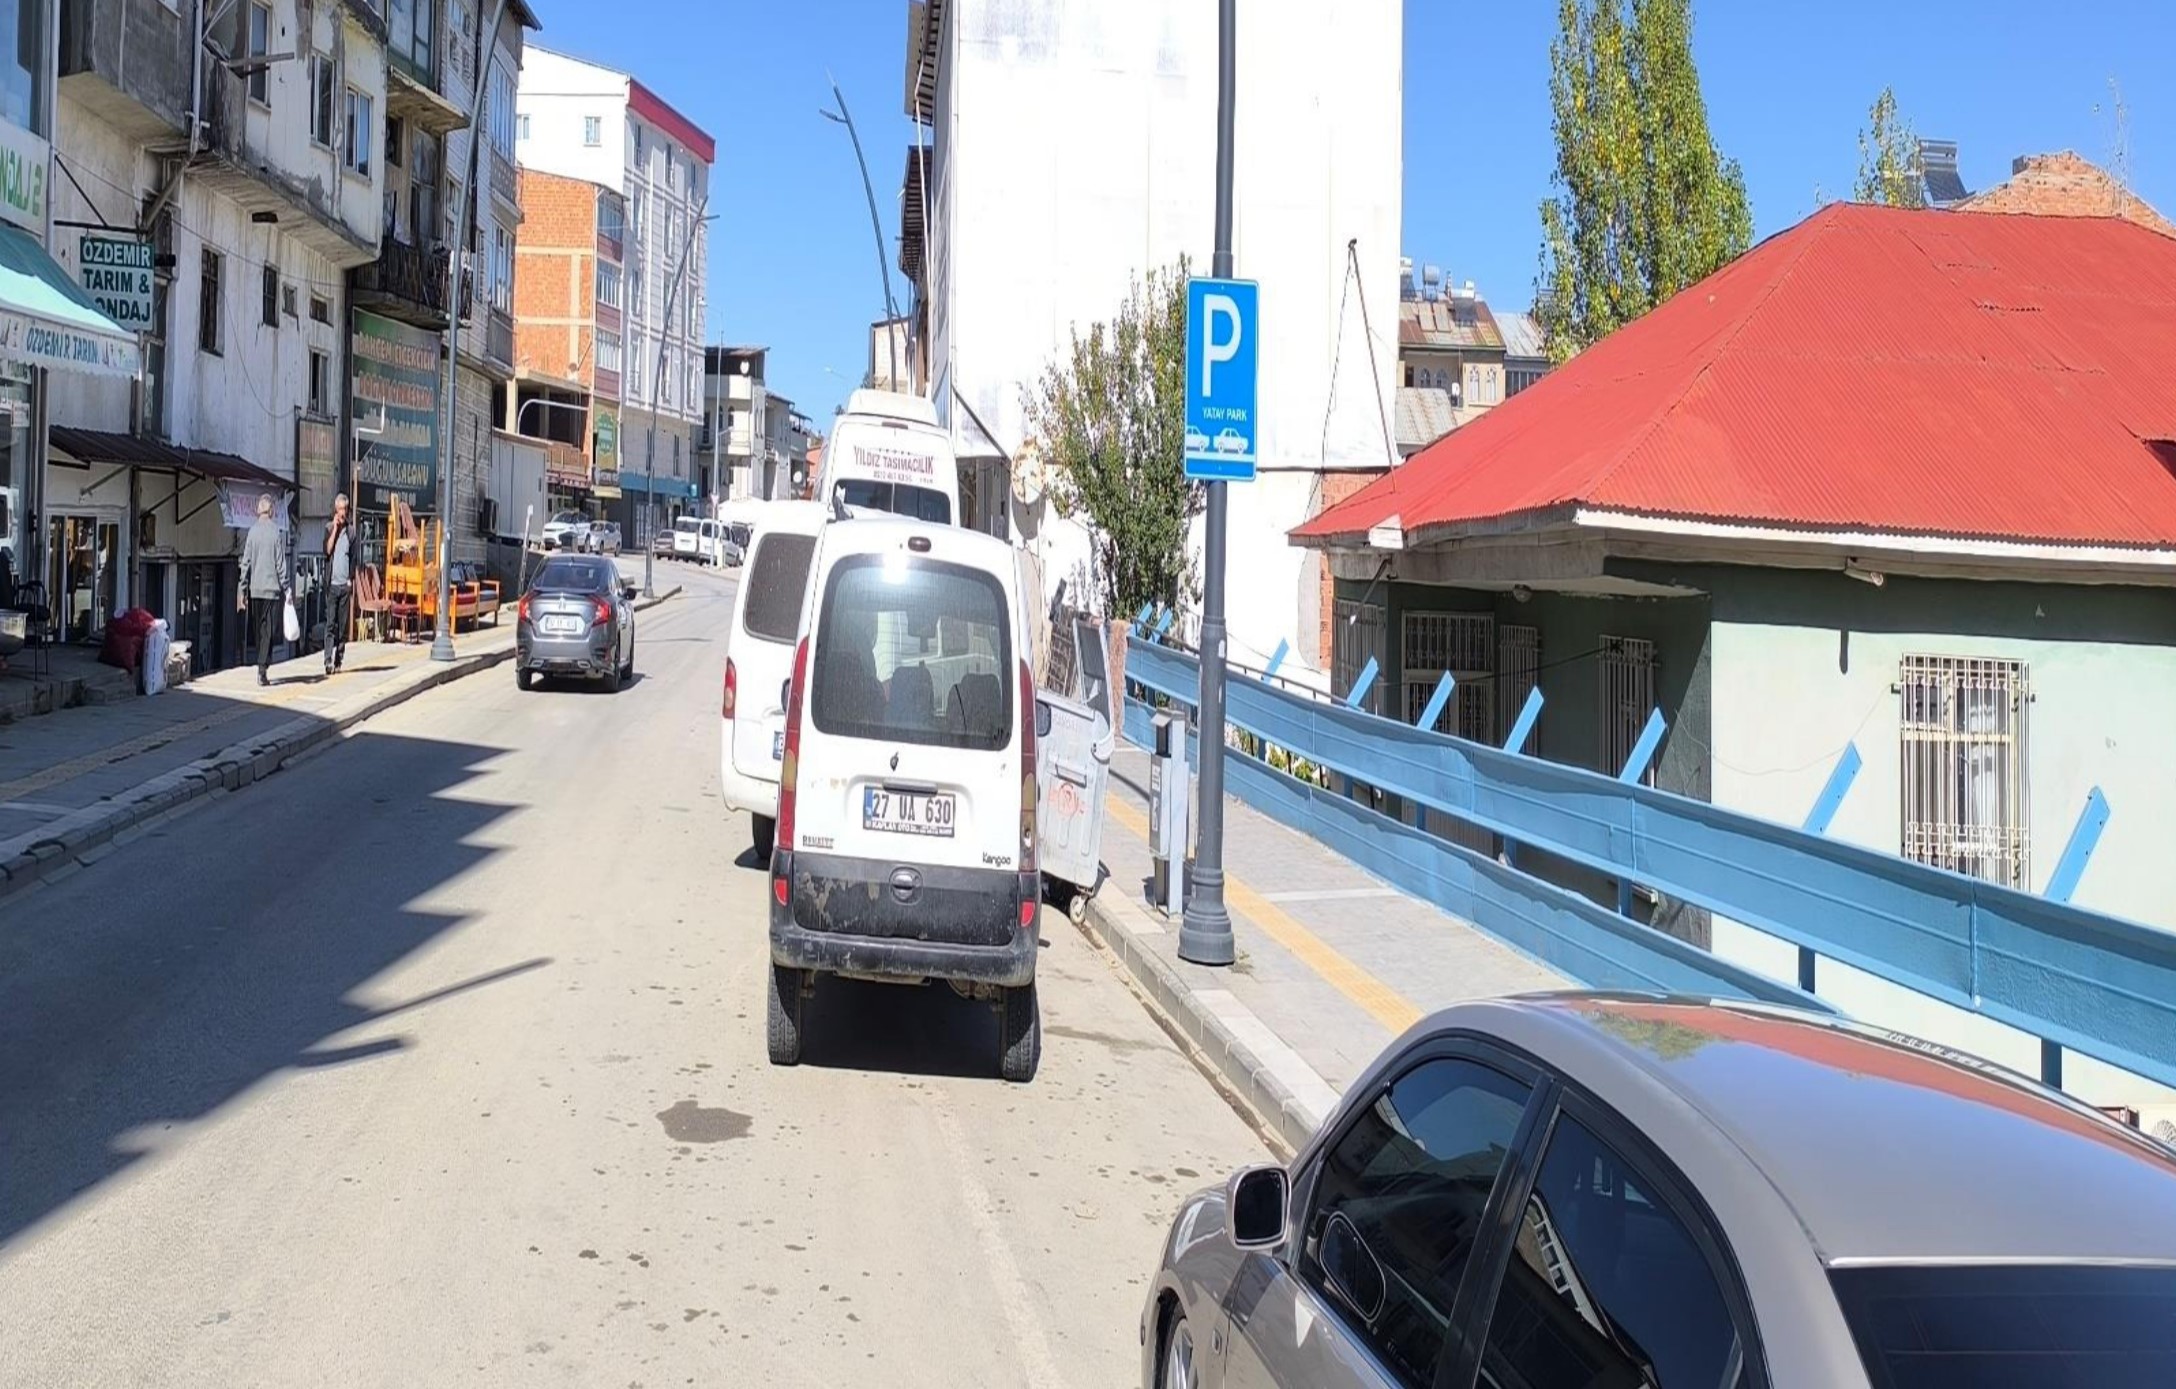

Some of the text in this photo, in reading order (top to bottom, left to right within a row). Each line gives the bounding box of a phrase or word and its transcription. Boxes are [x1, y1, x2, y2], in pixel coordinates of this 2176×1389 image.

[83, 268, 150, 294] TARIM &
[94, 297, 150, 321] NDAJ
[1202, 294, 1242, 398] P
[1202, 407, 1247, 422] YATAY PARK
[854, 446, 881, 467] YILDIZ
[872, 793, 951, 824] 27 UA 630
[982, 851, 1012, 868] Kangoo
